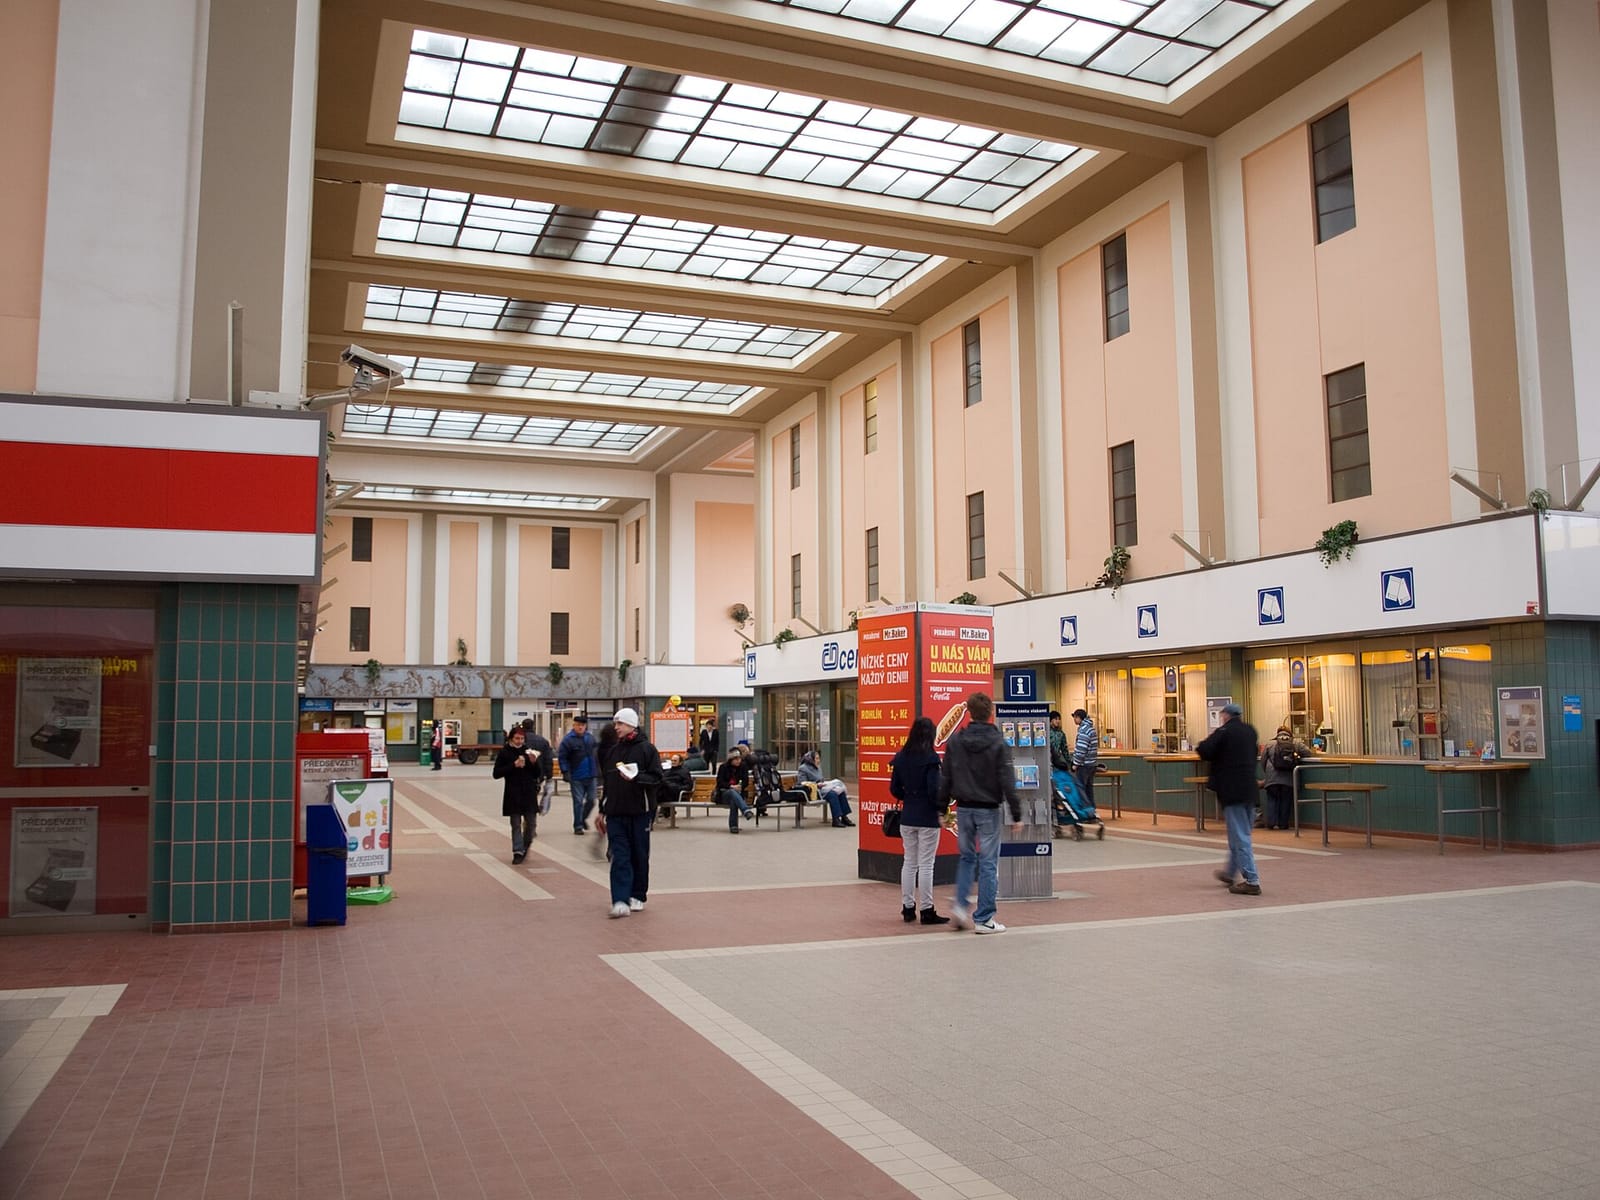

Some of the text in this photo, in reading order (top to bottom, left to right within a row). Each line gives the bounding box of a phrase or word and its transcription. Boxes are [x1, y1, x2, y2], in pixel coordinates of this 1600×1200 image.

[884, 628, 906, 639] Mr.Baker
[961, 629, 988, 639] Mr.Baker
[930, 643, 990, 661] U NÁS VÁM
[860, 652, 909, 669] NÍZKÉ CENY
[1419, 651, 1431, 680] 1
[930, 662, 964, 674] DVACKA
[1291, 660, 1304, 686] 2
[861, 671, 885, 685] KAŽDÝ
[861, 708, 882, 720] ROHLÍK
[861, 762, 879, 773] CHLÉB
[861, 800, 879, 811] KAŽDÝ
